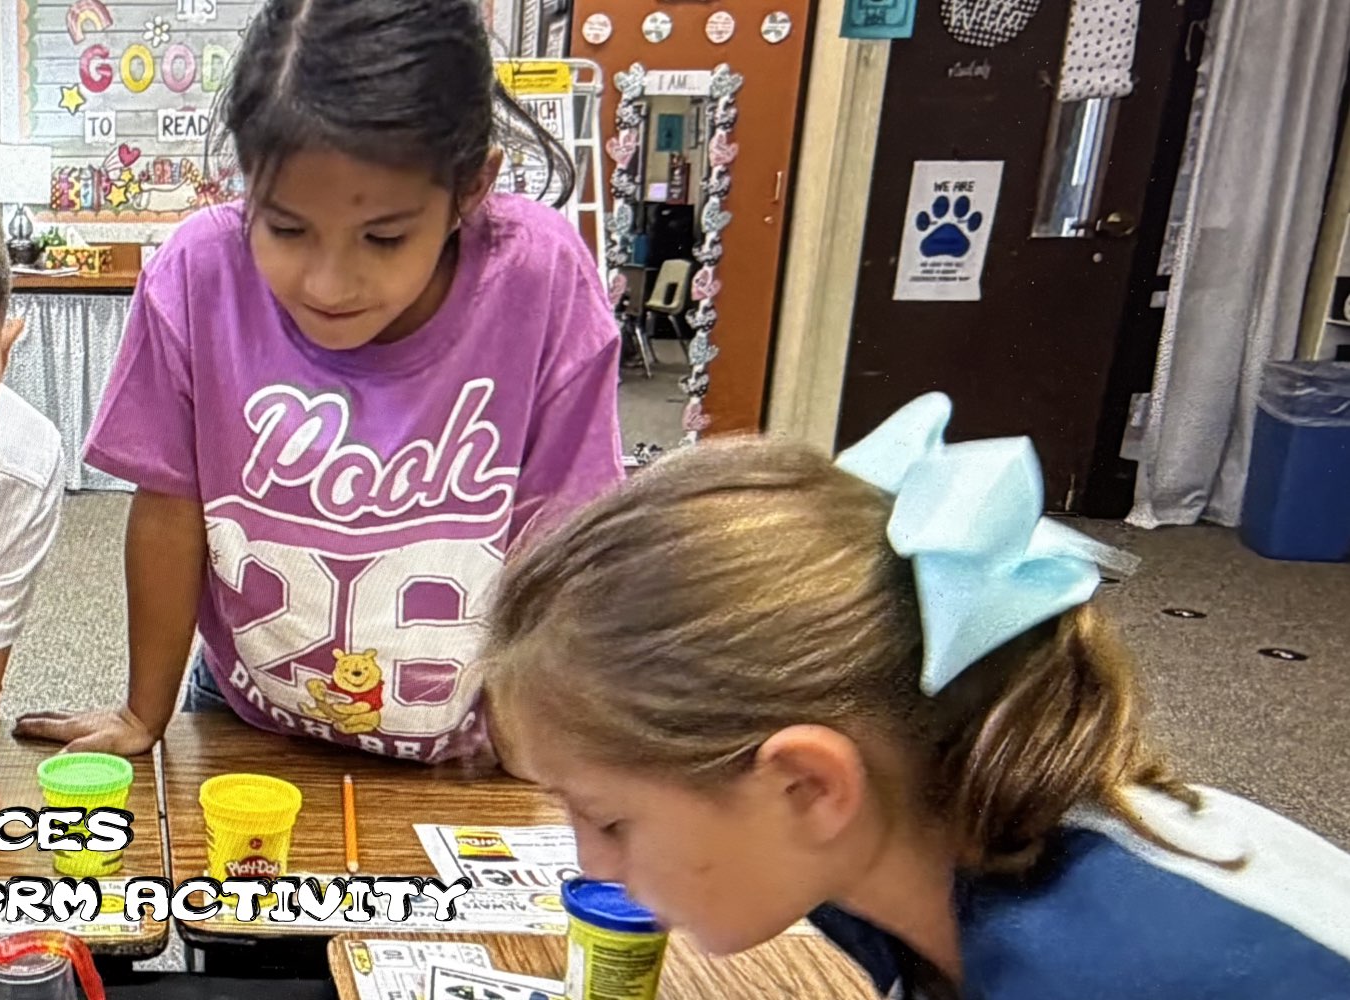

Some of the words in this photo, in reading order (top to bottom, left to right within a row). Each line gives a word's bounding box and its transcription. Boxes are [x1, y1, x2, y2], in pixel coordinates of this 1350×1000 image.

[79, 44, 231, 93] GOOD
[88, 116, 113, 136] TO
[161, 115, 209, 136] READ
[934, 181, 951, 192] WE
[953, 181, 976, 192] ARE
[243, 378, 519, 521] Pooh
[205, 514, 506, 737] 26
